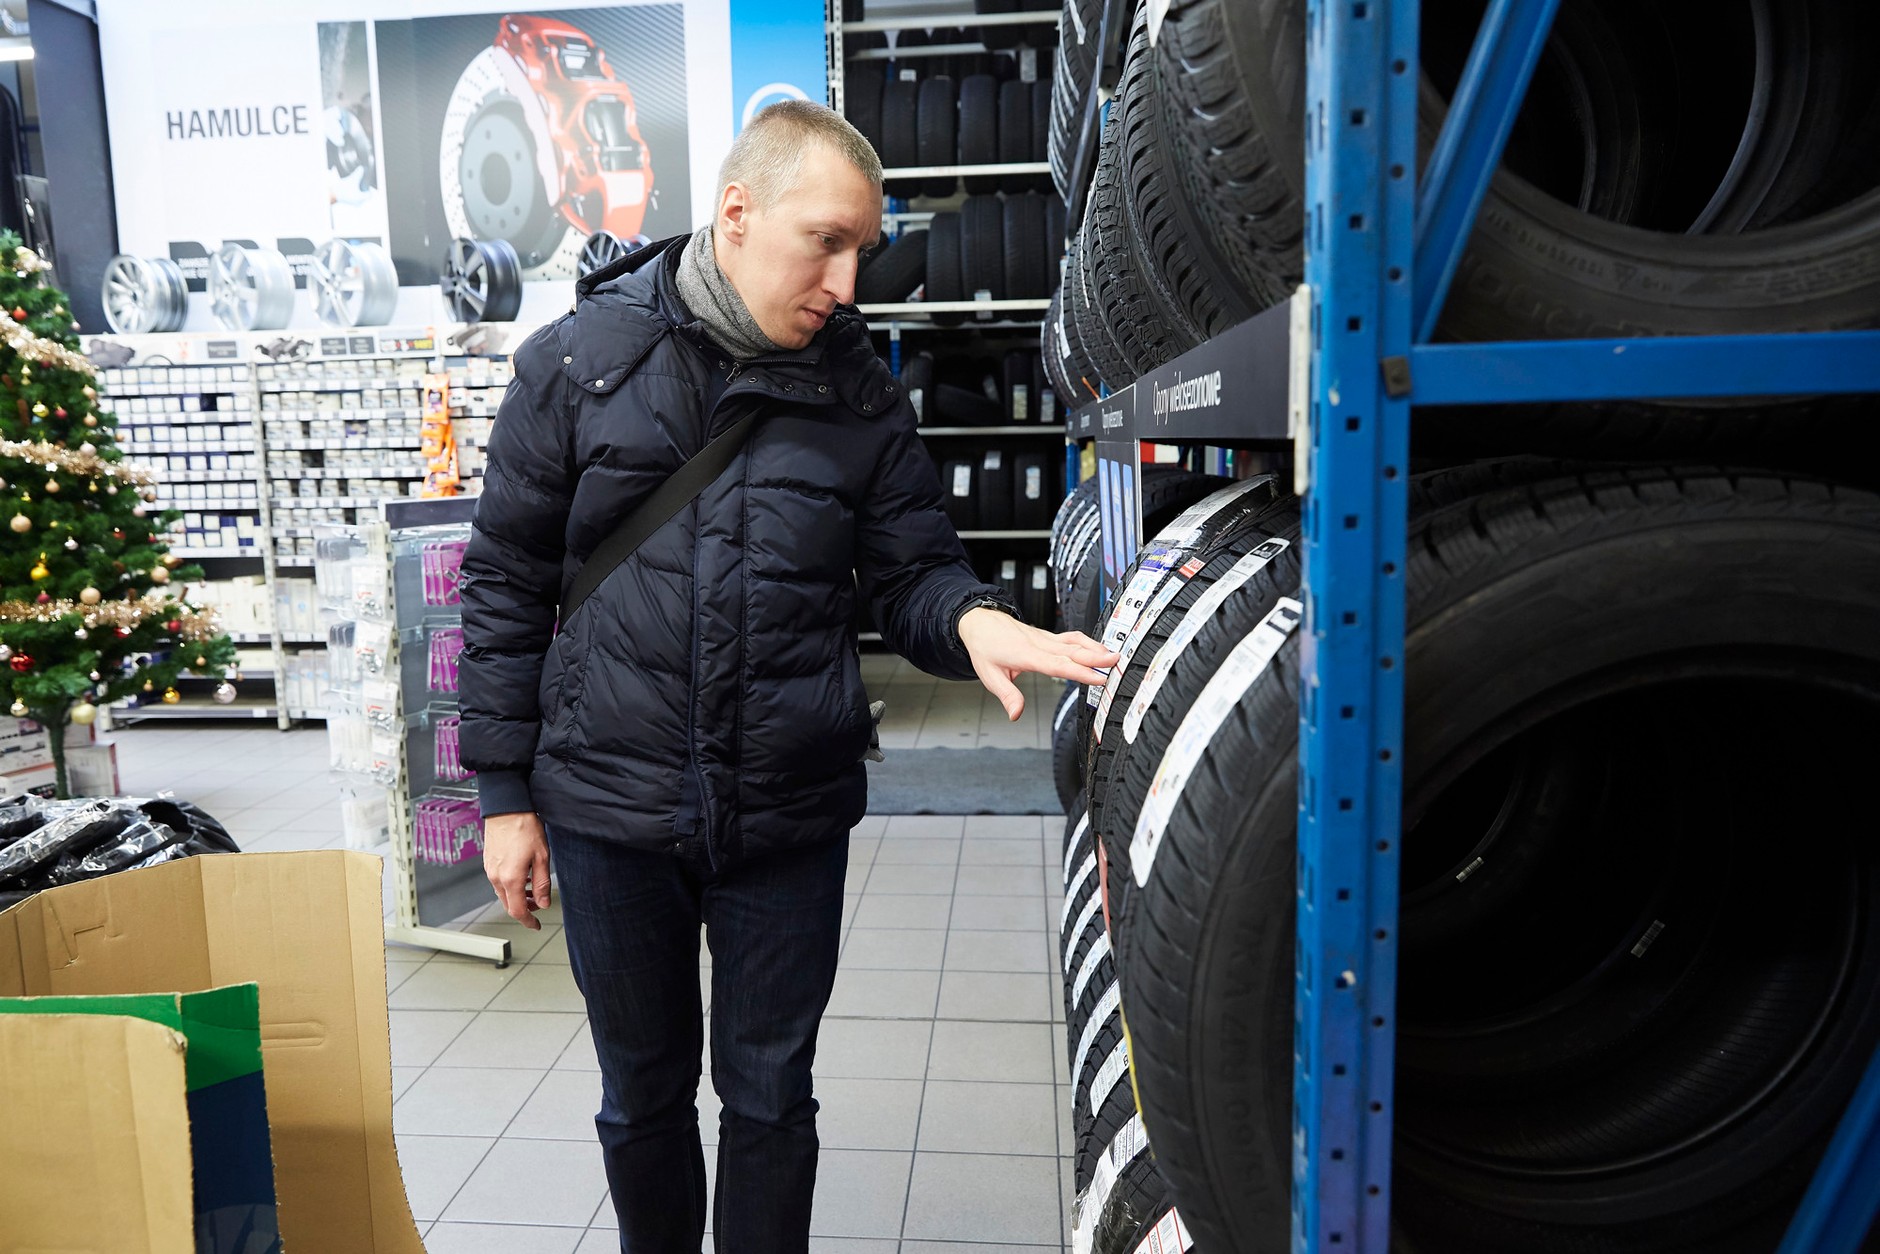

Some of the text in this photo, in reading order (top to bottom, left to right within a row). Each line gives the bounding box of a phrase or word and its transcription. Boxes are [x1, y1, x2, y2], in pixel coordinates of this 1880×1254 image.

[167, 105, 309, 140] HAMULCE
[1153, 380, 1170, 426] Opony
[1169, 370, 1221, 413] wielosezonowe
